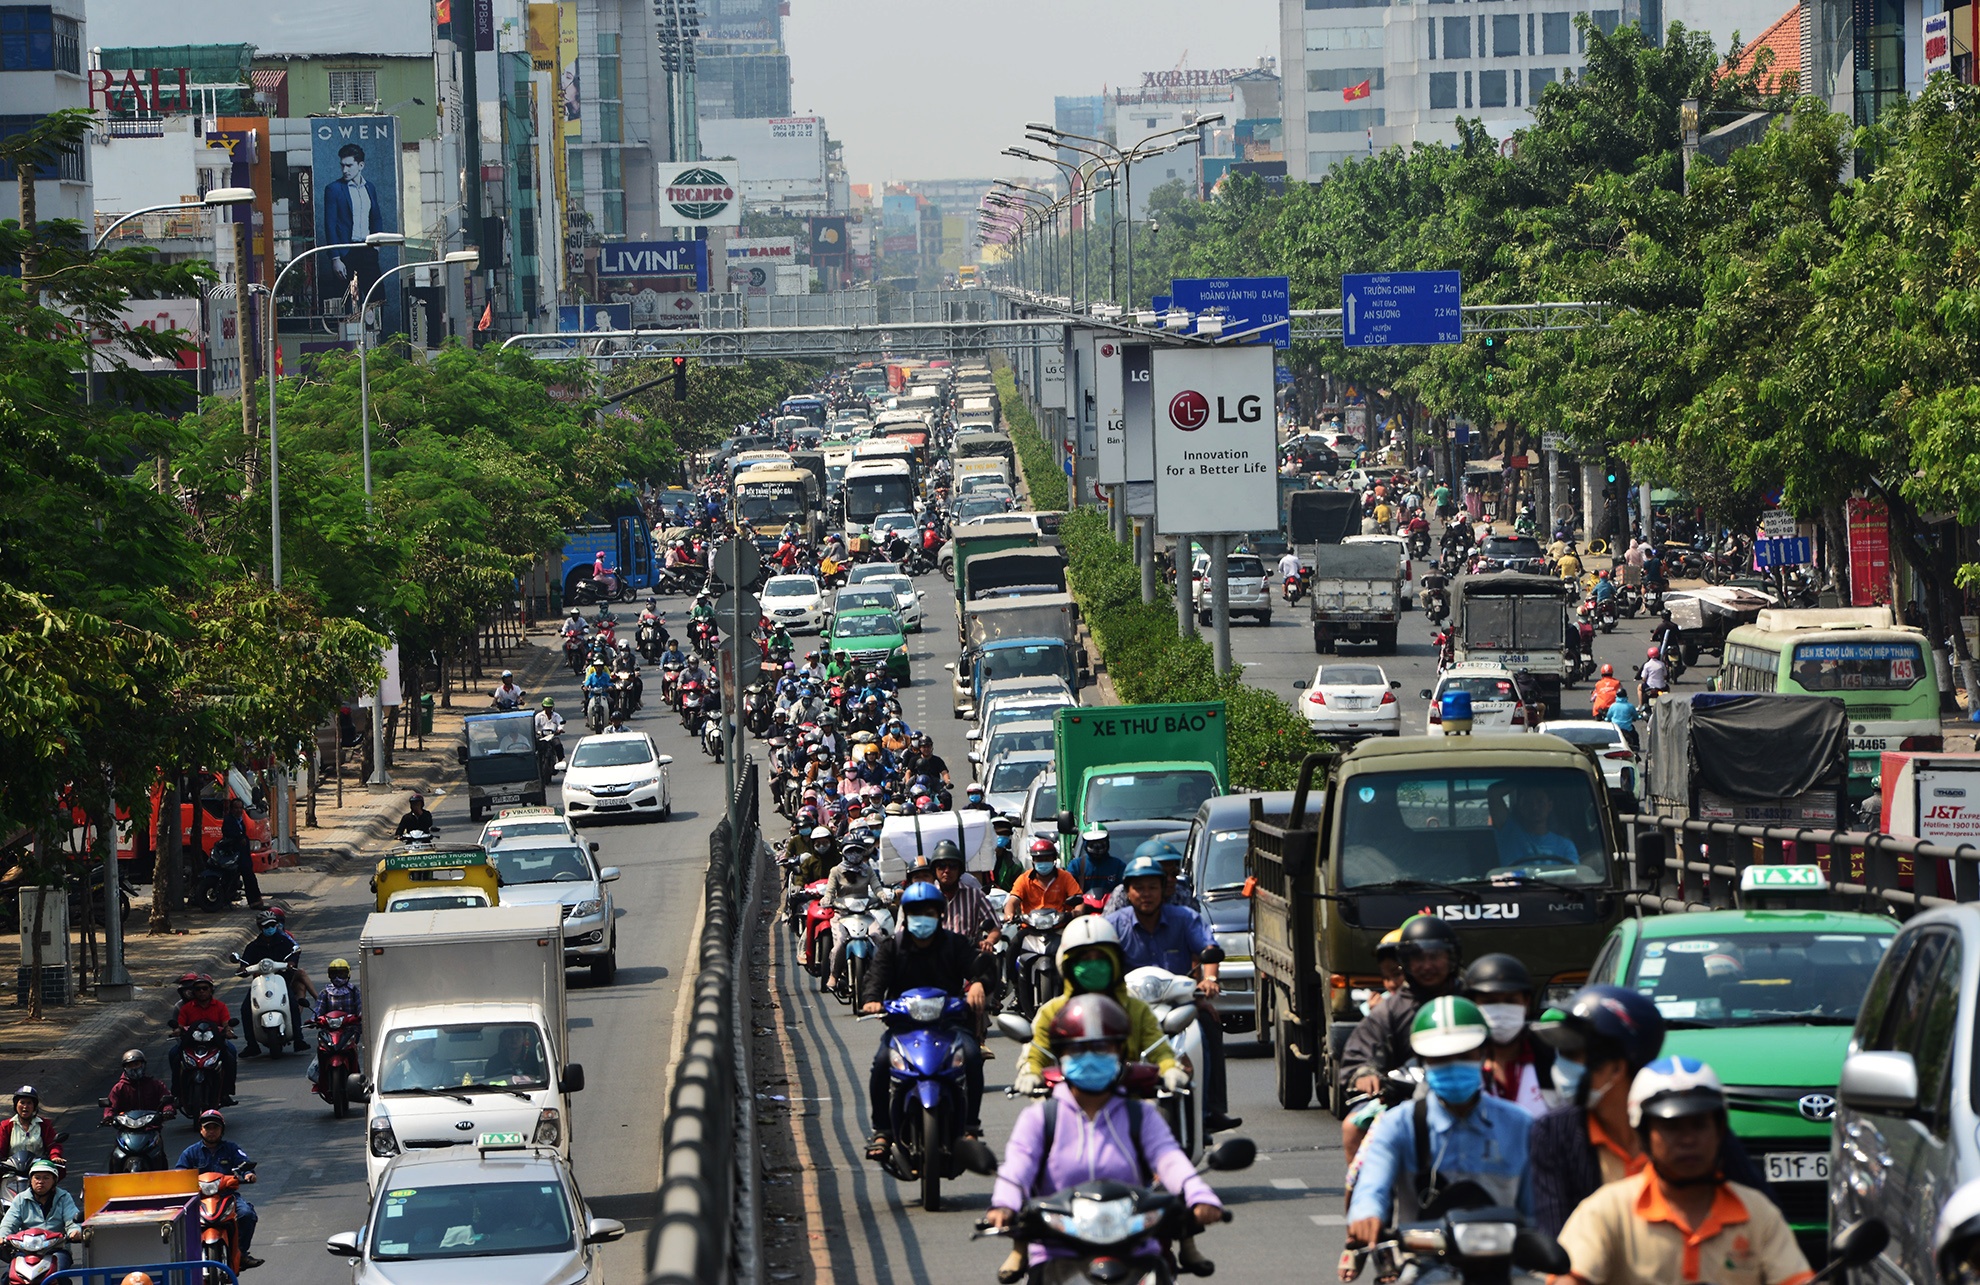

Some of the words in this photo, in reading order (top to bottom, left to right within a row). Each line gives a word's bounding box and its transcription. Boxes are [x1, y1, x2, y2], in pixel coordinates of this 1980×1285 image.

[318, 124, 388, 140] OWEN
[666, 187, 734, 201] TECAPRO
[601, 248, 678, 272] LIVINI
[1200, 289, 1225, 300] HOÀNG
[1226, 288, 1242, 299] VĂN
[1273, 289, 1285, 298] Km
[1445, 284, 1457, 293] Km
[1363, 311, 1375, 319] AN
[1446, 308, 1458, 317] Km
[1438, 332, 1445, 341] 18
[1446, 332, 1458, 341] Km
[1132, 370, 1149, 382] LG
[1217, 395, 1262, 423] LG
[1184, 449, 1249, 460] Innovation
[1166, 465, 1185, 476] for
[1200, 464, 1240, 475] Better
[1244, 462, 1267, 473] Life
[1800, 647, 1814, 658] BẾN
[1815, 648, 1824, 657] XE
[1825, 647, 1839, 659] CHỢ
[1859, 647, 1873, 659] CHỢ
[1891, 646, 1914, 657] THÀNH
[1892, 660, 1913, 678] 145
[1841, 675, 1861, 687] 145
[1093, 720, 1116, 736] XE
[1120, 716, 1159, 735] THƯ
[1165, 713, 1206, 733] BÁO
[1924, 806, 1965, 819] J&T
[1436, 903, 1520, 921] ISUZU
